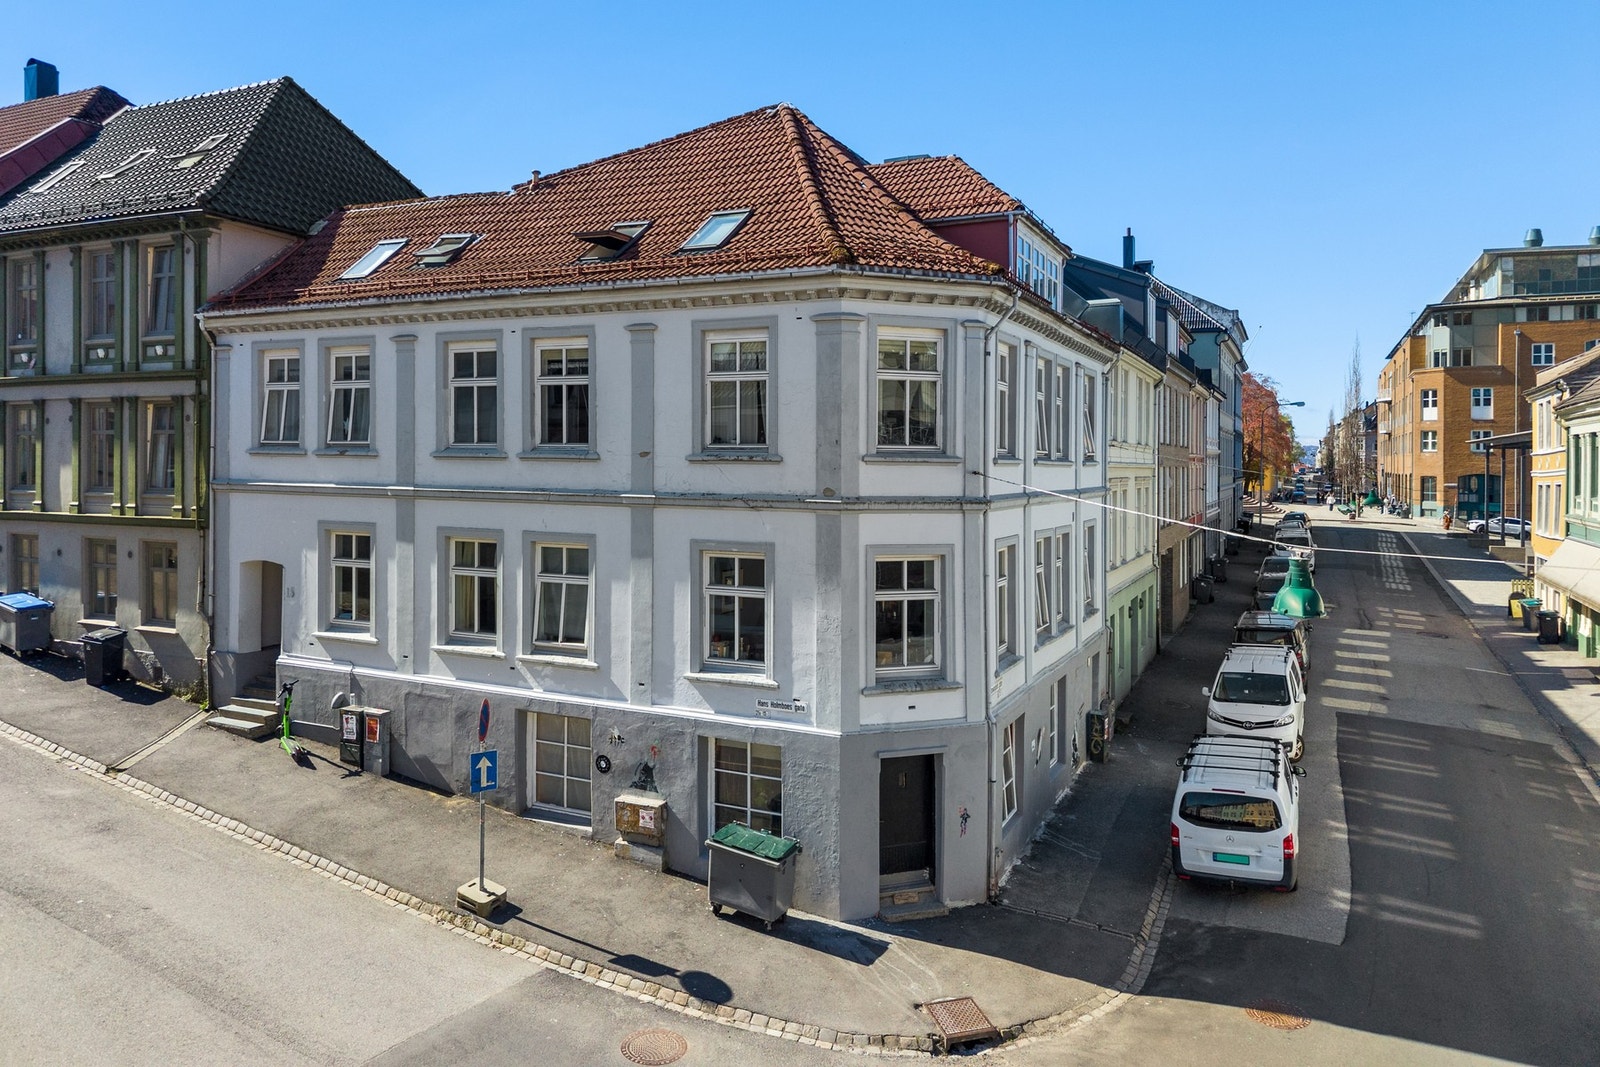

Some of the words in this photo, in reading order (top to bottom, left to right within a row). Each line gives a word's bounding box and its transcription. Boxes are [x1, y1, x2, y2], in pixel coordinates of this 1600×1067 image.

[757, 699, 769, 708] Hans
[770, 701, 793, 711] Holmboes
[794, 704, 805, 713] gate
